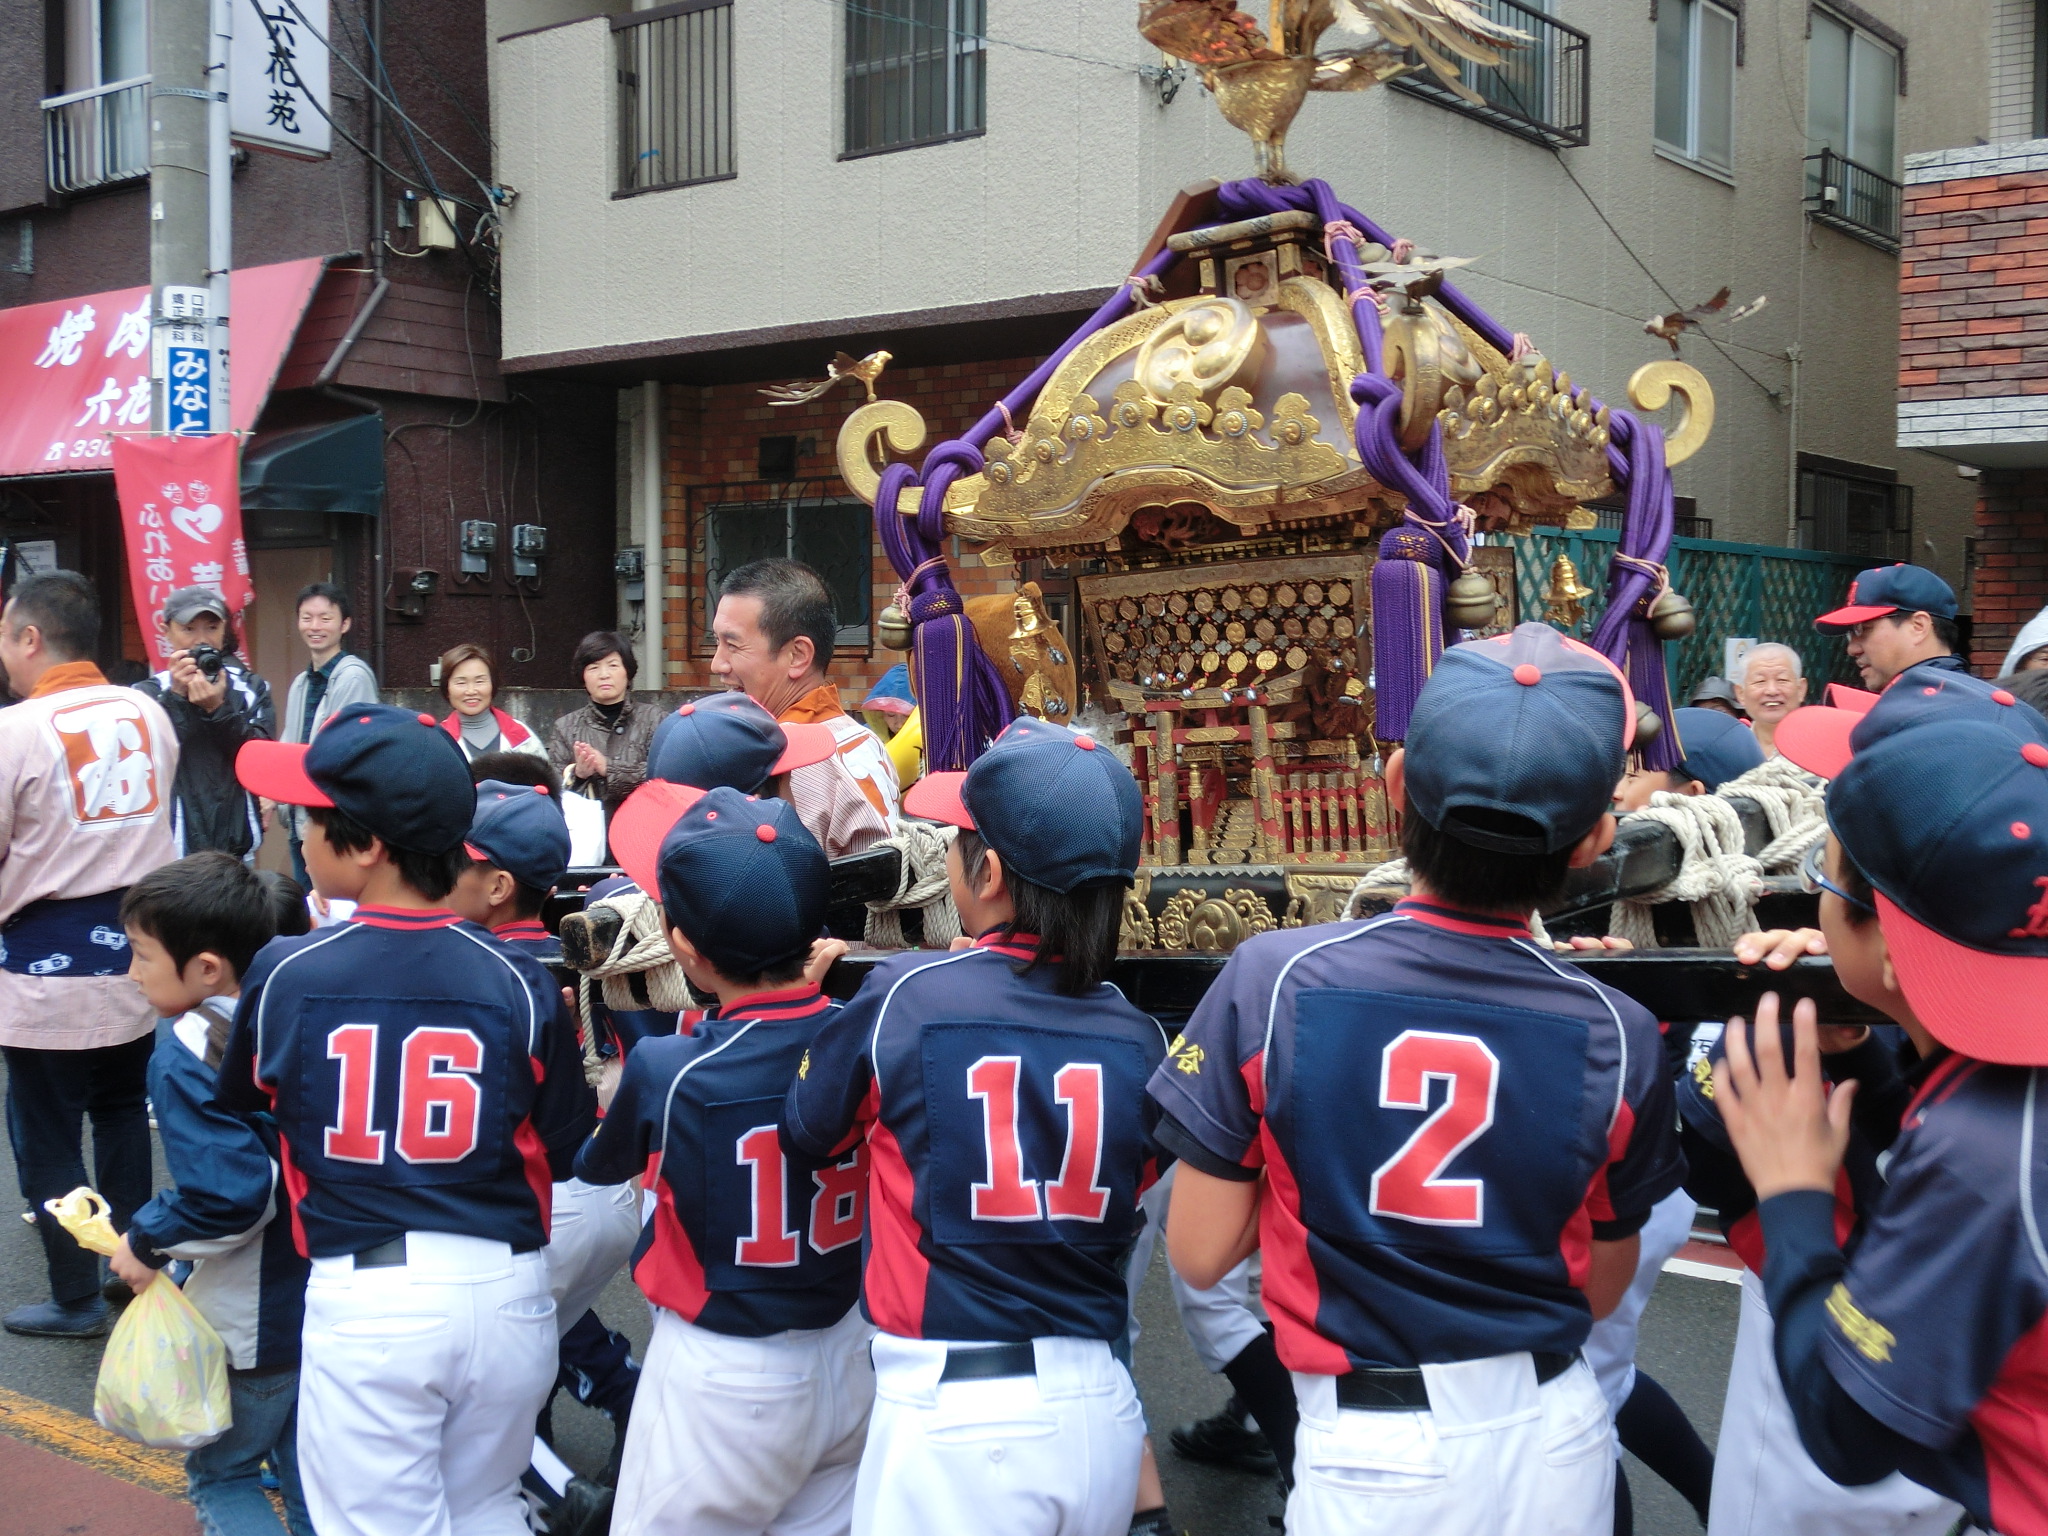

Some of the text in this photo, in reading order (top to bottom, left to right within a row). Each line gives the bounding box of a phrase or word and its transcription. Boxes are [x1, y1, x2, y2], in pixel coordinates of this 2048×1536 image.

[264, 5, 301, 134] 六花苑
[33, 293, 151, 368] 焼肉
[172, 350, 208, 436] みなと
[324, 1024, 484, 1165] 16
[966, 1055, 1111, 1224] 11
[1368, 1029, 1501, 1228] 2
[734, 1123, 869, 1268] 18
